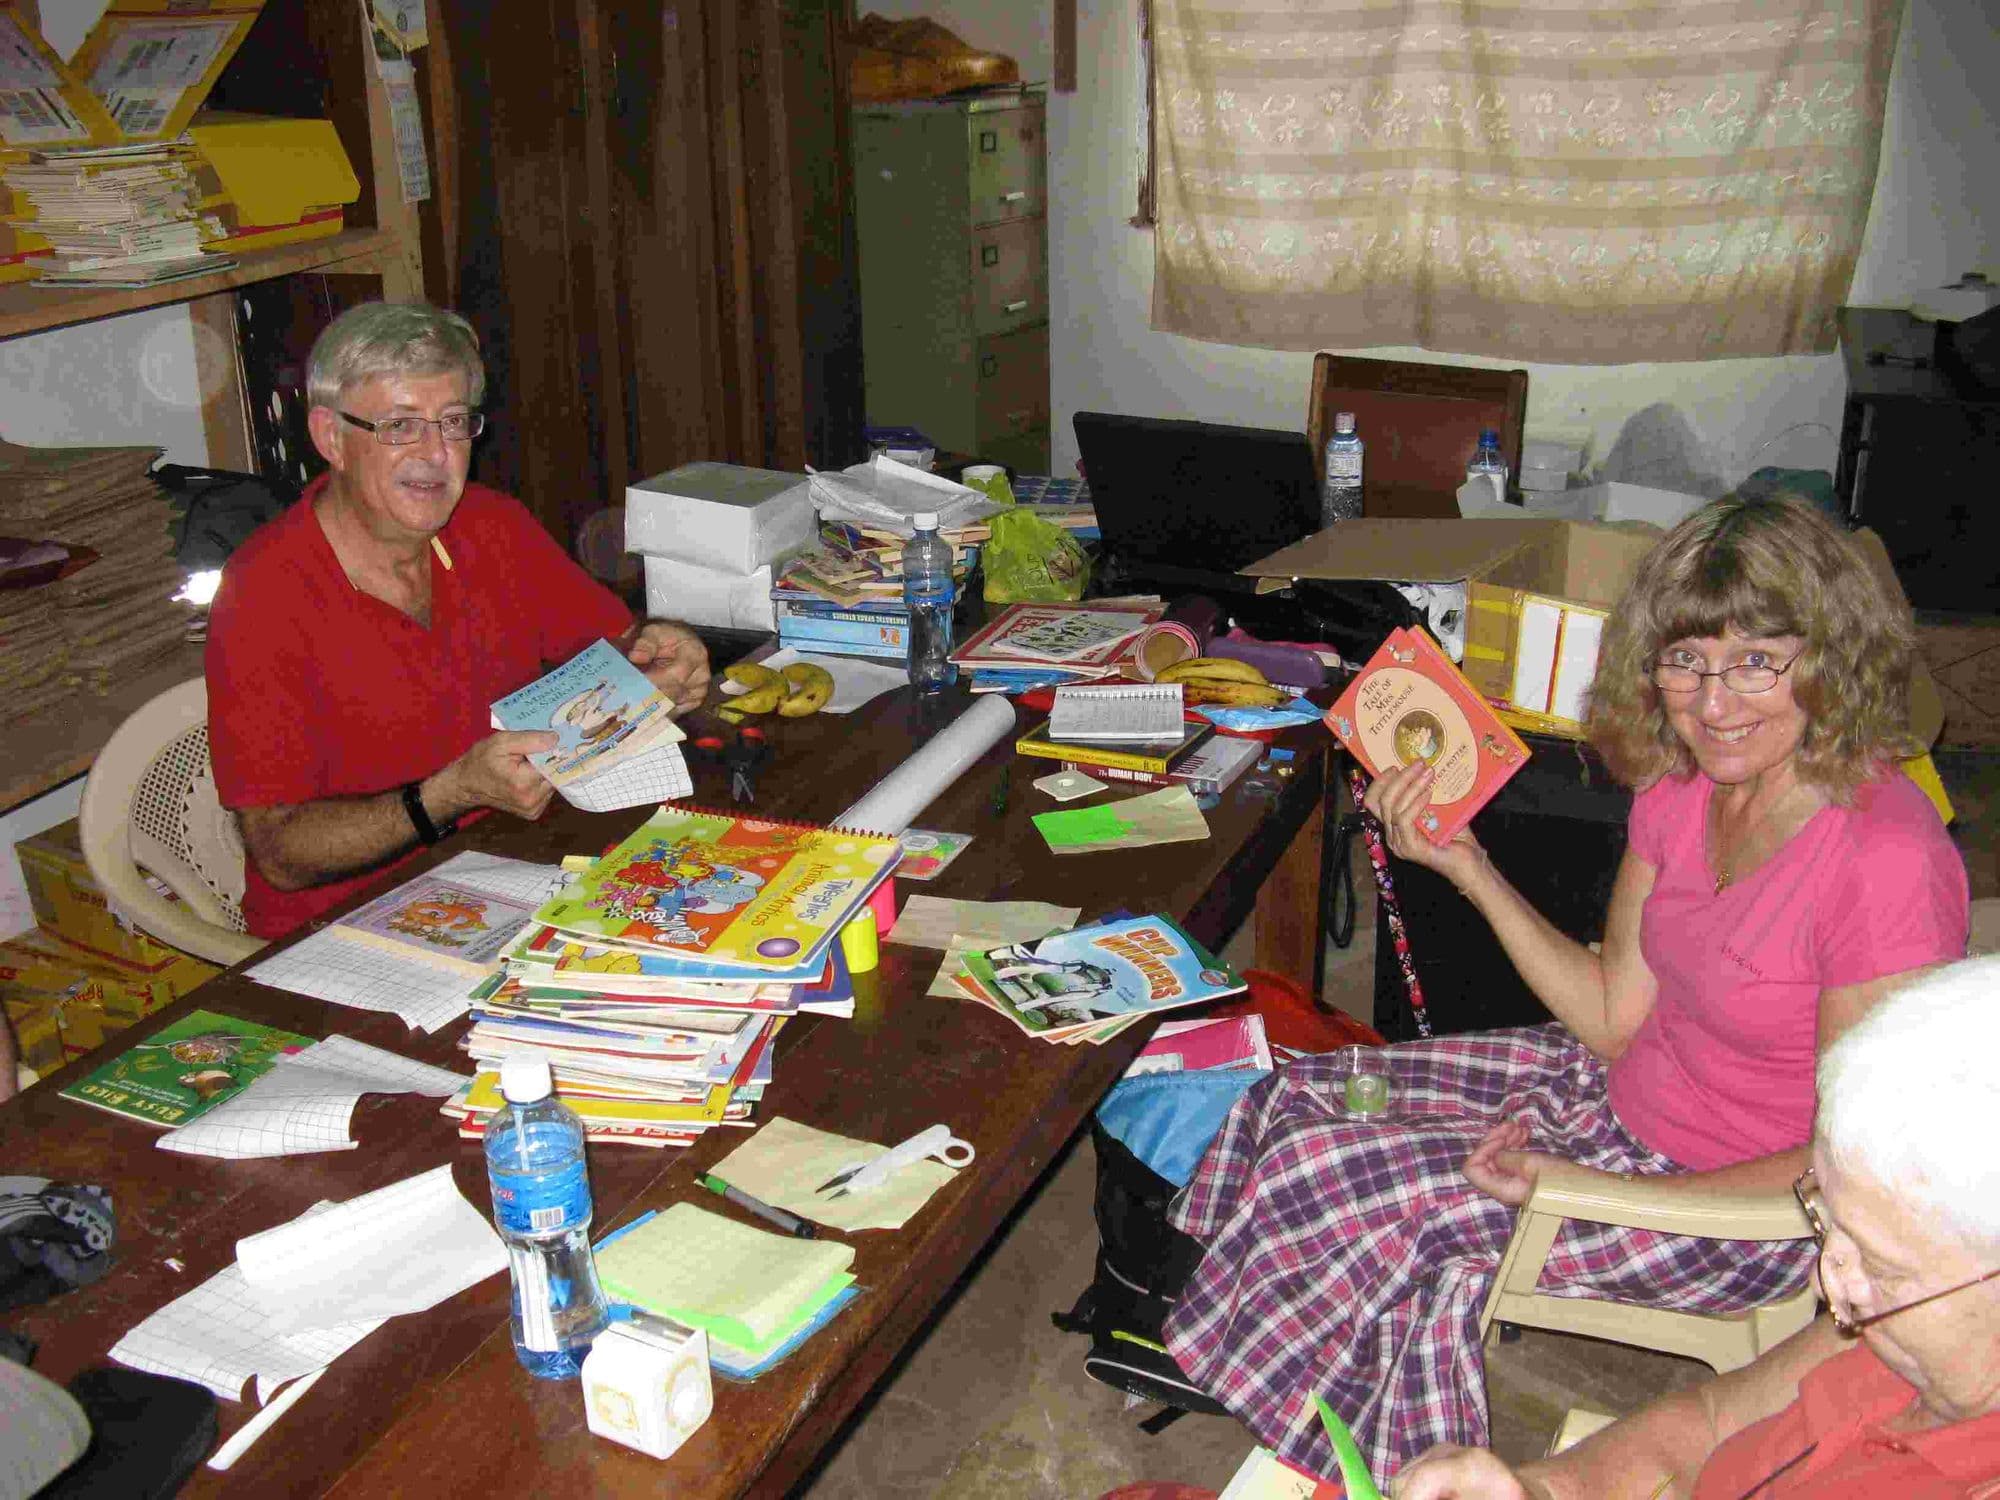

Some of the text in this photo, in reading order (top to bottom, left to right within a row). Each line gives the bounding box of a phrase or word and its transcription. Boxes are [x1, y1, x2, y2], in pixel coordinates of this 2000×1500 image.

[1108, 766, 1133, 780] HUMAN
[1134, 771, 1153, 783] BODY
[793, 863, 832, 897] Animal
[750, 892, 797, 928] Antics
[797, 879, 854, 920] Tweenies
[1125, 927, 1180, 957] CUP
[1094, 932, 1182, 1000] WINNERS
[80, 1085, 129, 1106] BIRD
[128, 1099, 186, 1121] BUSY
